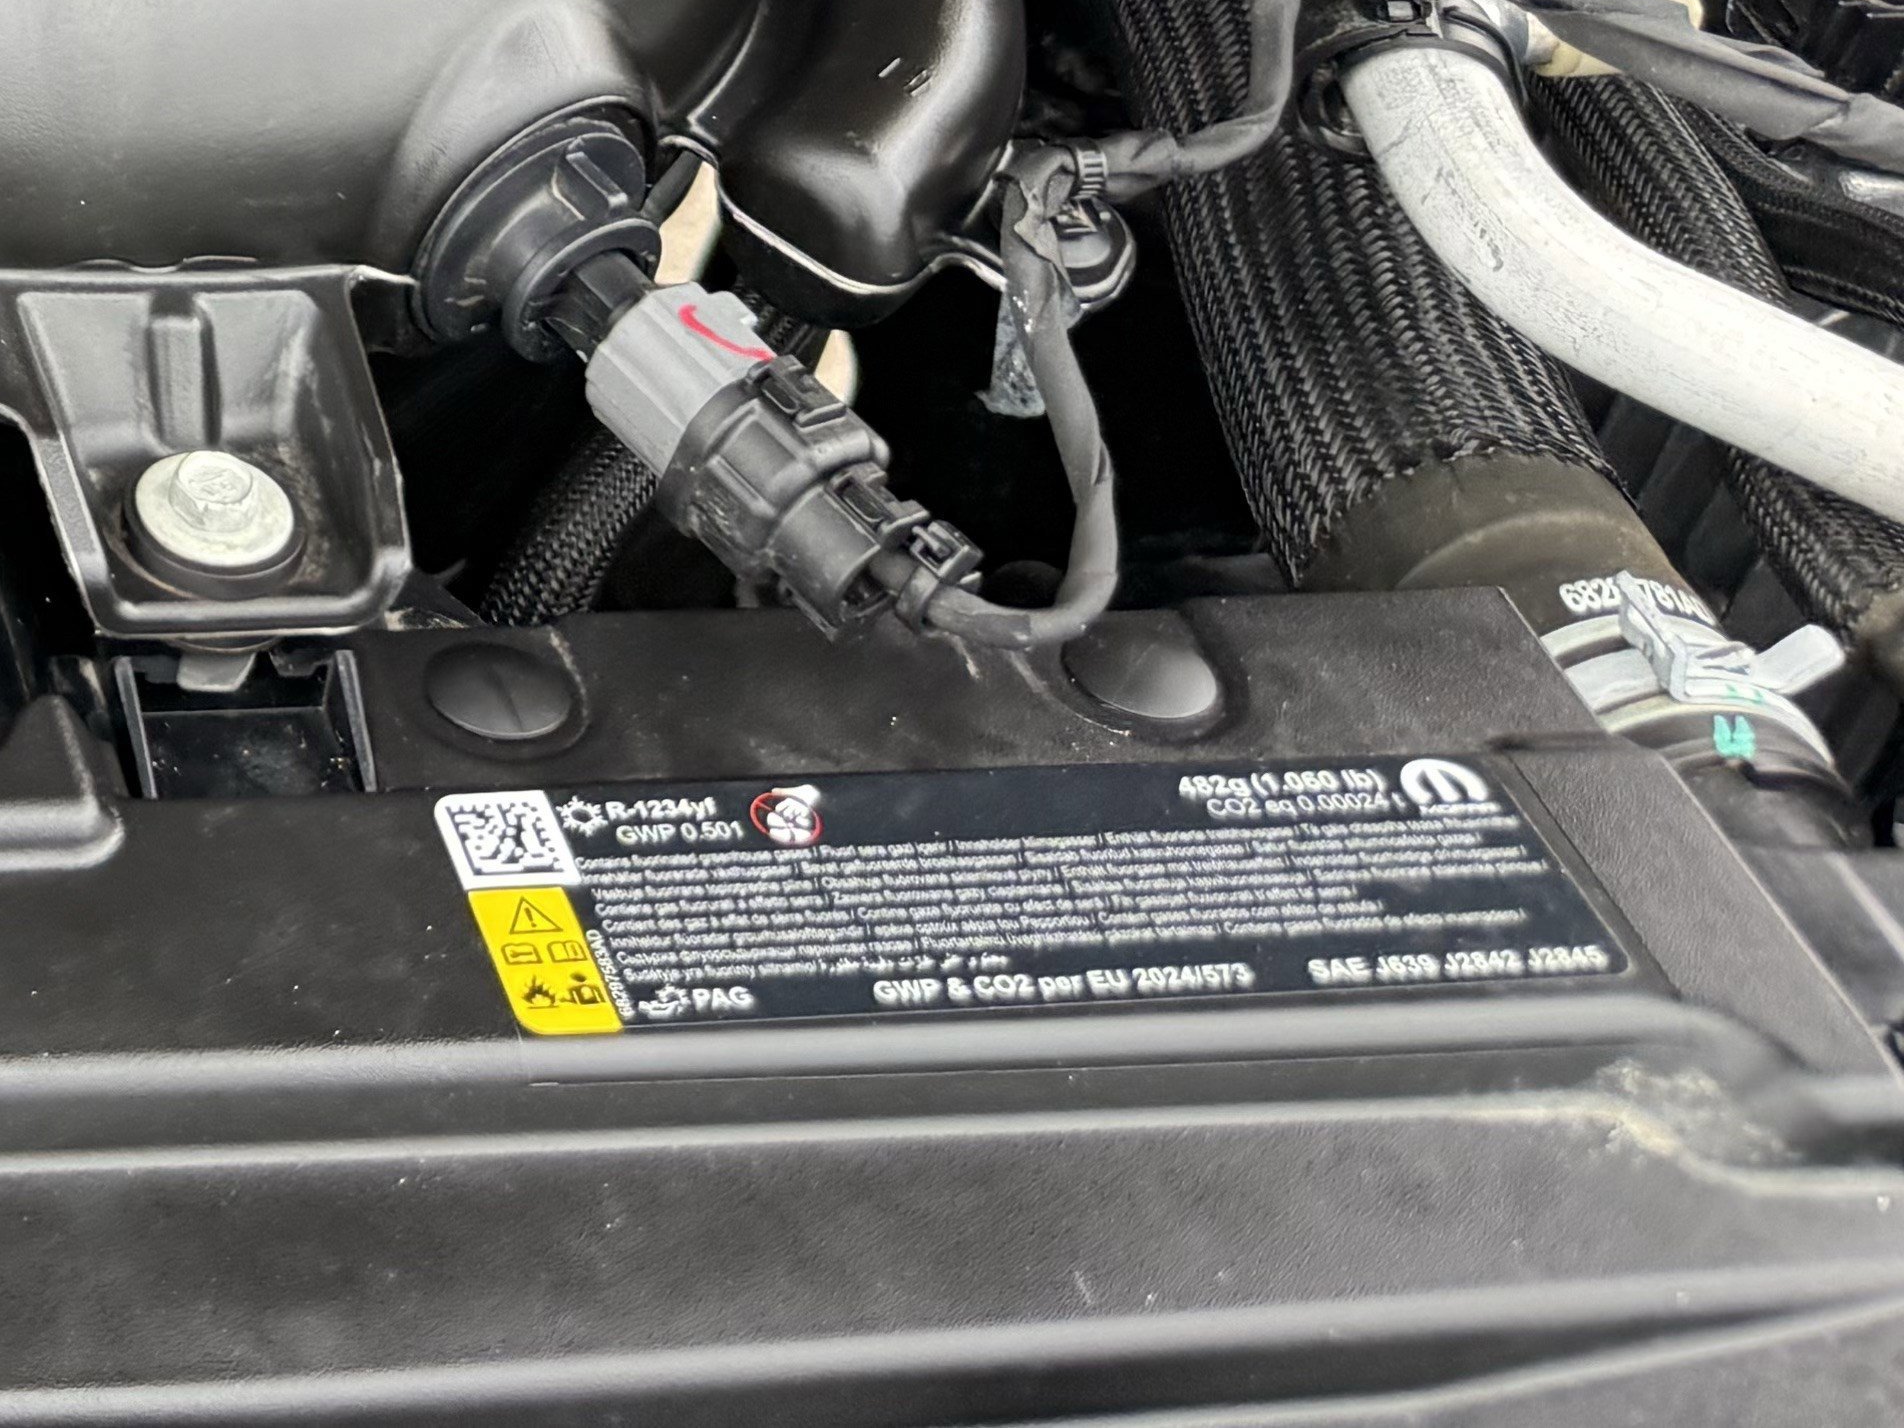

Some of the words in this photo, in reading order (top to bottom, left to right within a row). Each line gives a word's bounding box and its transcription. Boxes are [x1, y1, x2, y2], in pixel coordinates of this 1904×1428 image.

[1178, 775, 1250, 800] 482g
[1251, 770, 1339, 798] (1.060
[1342, 768, 1386, 793] lb)
[605, 795, 718, 826] R-1234yf
[1206, 796, 1259, 820] CO2
[1265, 796, 1297, 820] eq
[1298, 791, 1390, 814] 0.00024
[615, 824, 678, 845] GWP
[681, 821, 744, 843] 0.501
[1307, 956, 1373, 984] SAE
[1375, 952, 1440, 980] J639
[1444, 949, 1524, 977] J2842
[1527, 944, 1610, 972] J2845
[693, 986, 757, 1011] PAG
[873, 977, 942, 1005] GWP
[947, 976, 972, 1002] &
[973, 973, 1037, 1001] CO2
[1038, 974, 1086, 1003] per
[1086, 968, 1130, 995] EU
[1132, 962, 1256, 994] 2024/573
